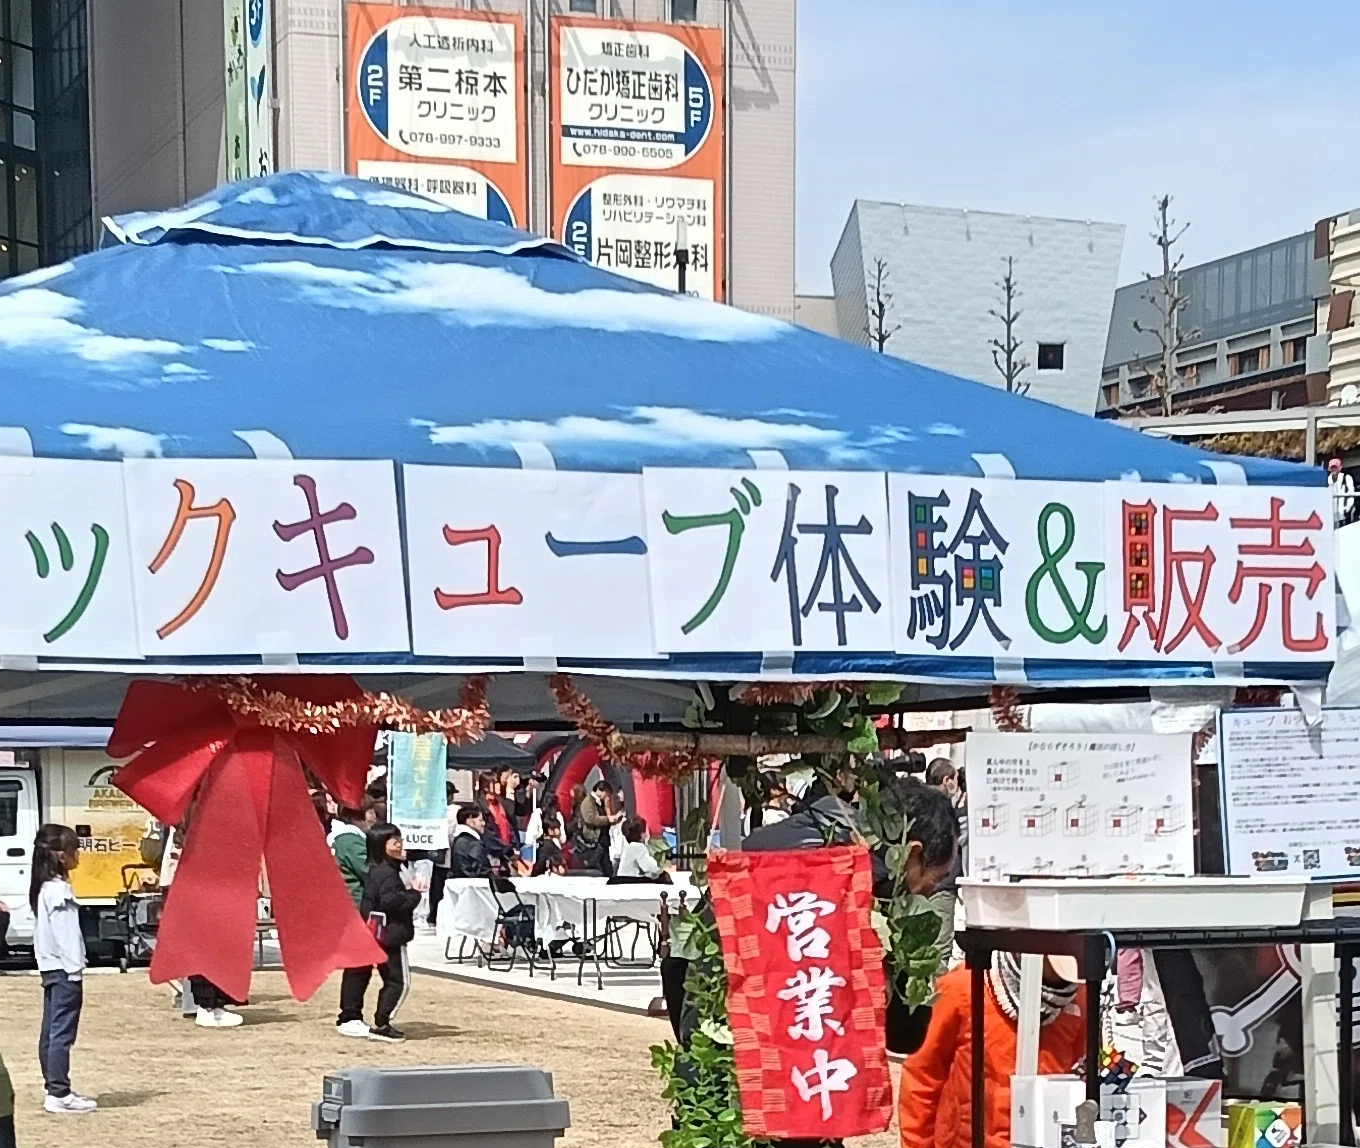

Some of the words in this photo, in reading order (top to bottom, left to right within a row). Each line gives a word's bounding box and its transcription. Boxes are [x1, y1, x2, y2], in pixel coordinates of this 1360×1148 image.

[367, 65, 384, 106] 2F
[398, 64, 507, 98] 第二椋本
[566, 67, 679, 102] ひだか矯正歯科
[417, 100, 496, 123] クリニック
[588, 103, 665, 124] クリニック
[688, 86, 704, 127] 5F
[765, 891, 858, 1121] 営業中
